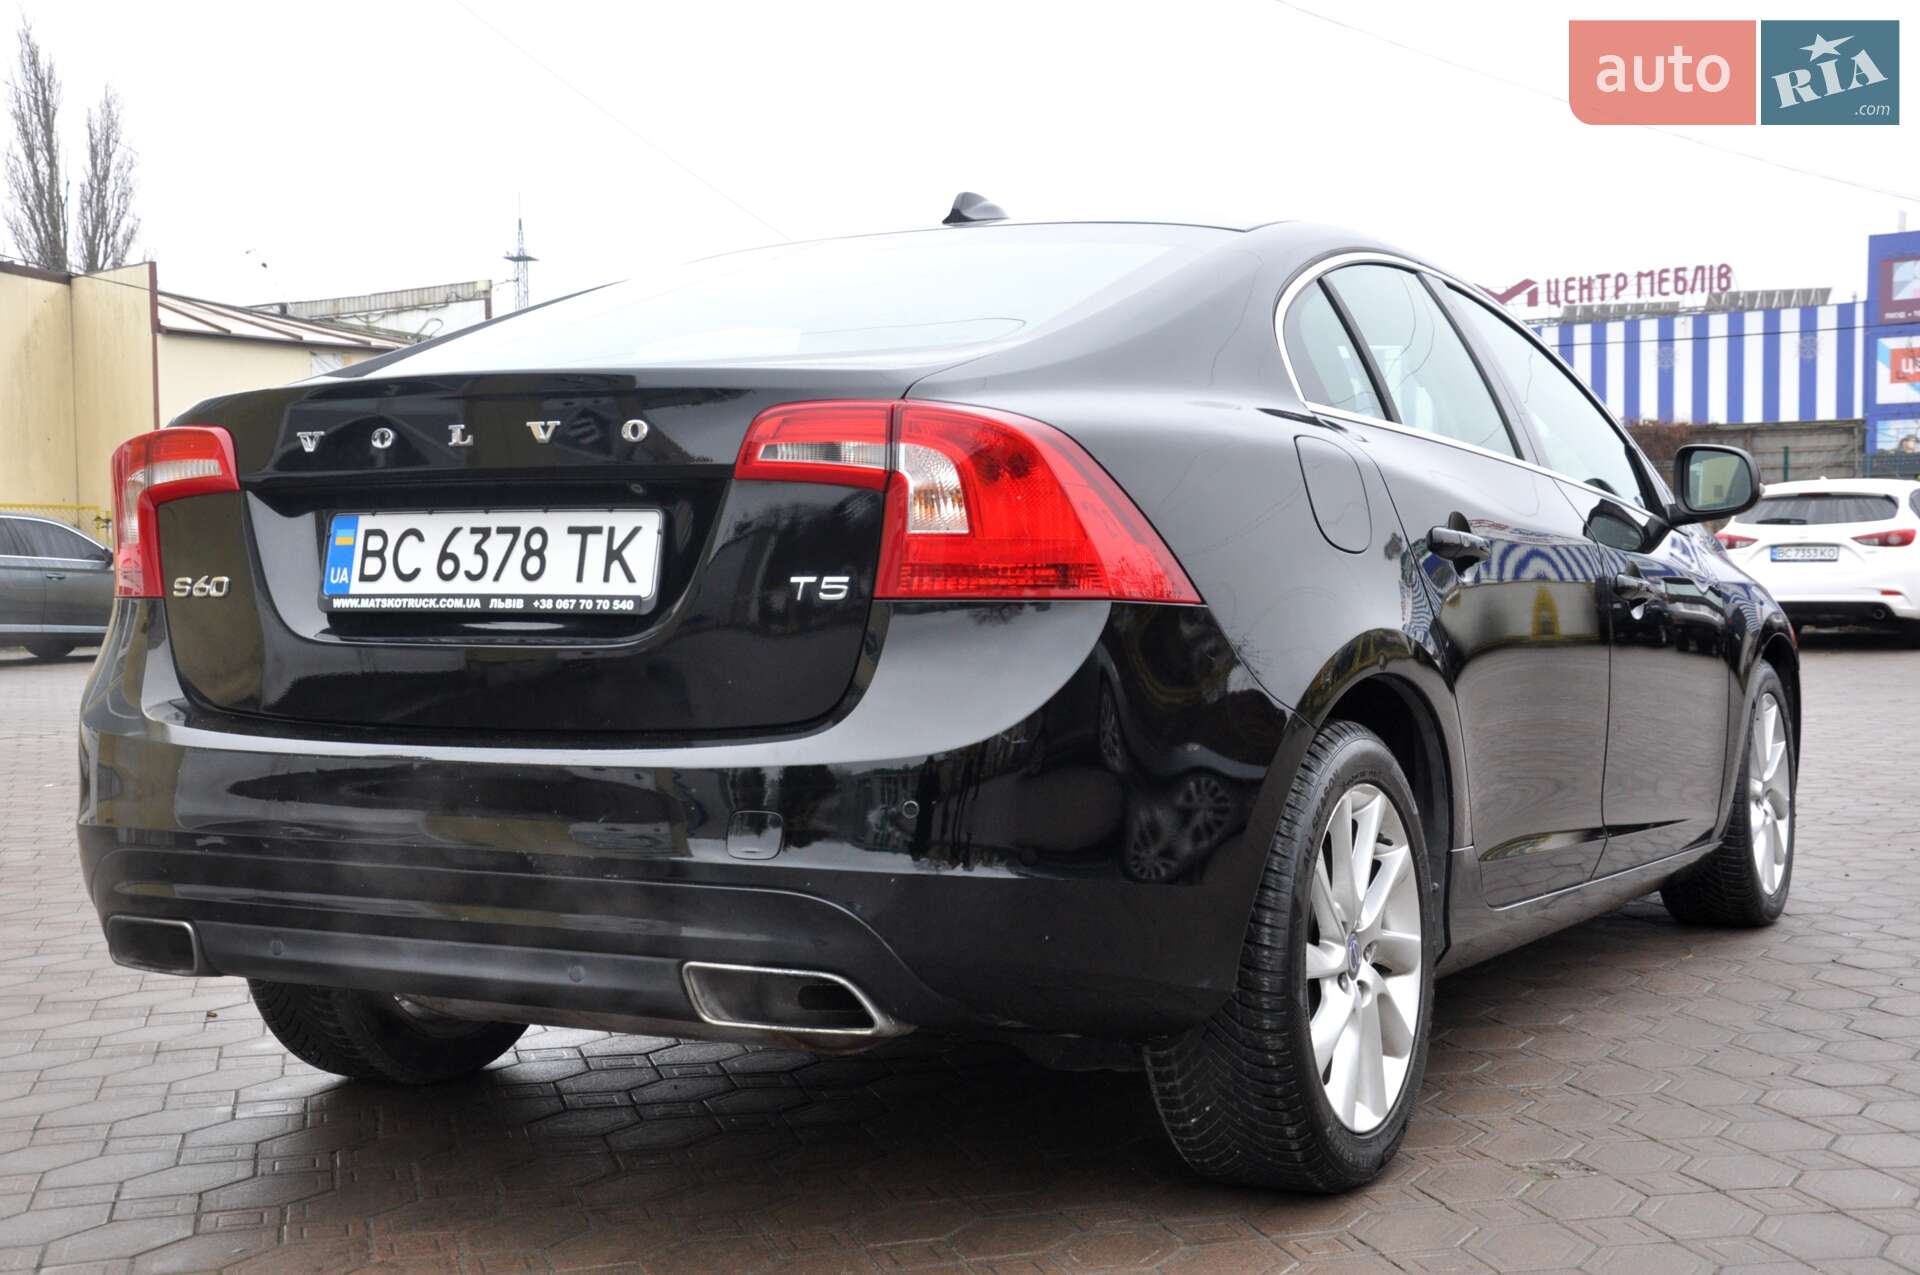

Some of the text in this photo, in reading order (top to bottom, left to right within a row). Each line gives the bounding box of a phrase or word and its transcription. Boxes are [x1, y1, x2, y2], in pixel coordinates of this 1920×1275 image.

[1546, 263, 1733, 307] ЦЕНТР МЕБЛІВ
[297, 418, 649, 453] VOLVO
[358, 525, 643, 583] BC 6378 TK
[173, 575, 229, 597] S60
[330, 567, 349, 584] UA
[790, 576, 850, 600] T5
[332, 598, 481, 609] WWW.MATSKOTRUCK.COM.UA
[489, 598, 524, 609] ЛЬВІВ
[555, 599, 577, 609] 067
[579, 599, 593, 610] 70
[596, 600, 610, 610] 70
[612, 600, 634, 611] 540
